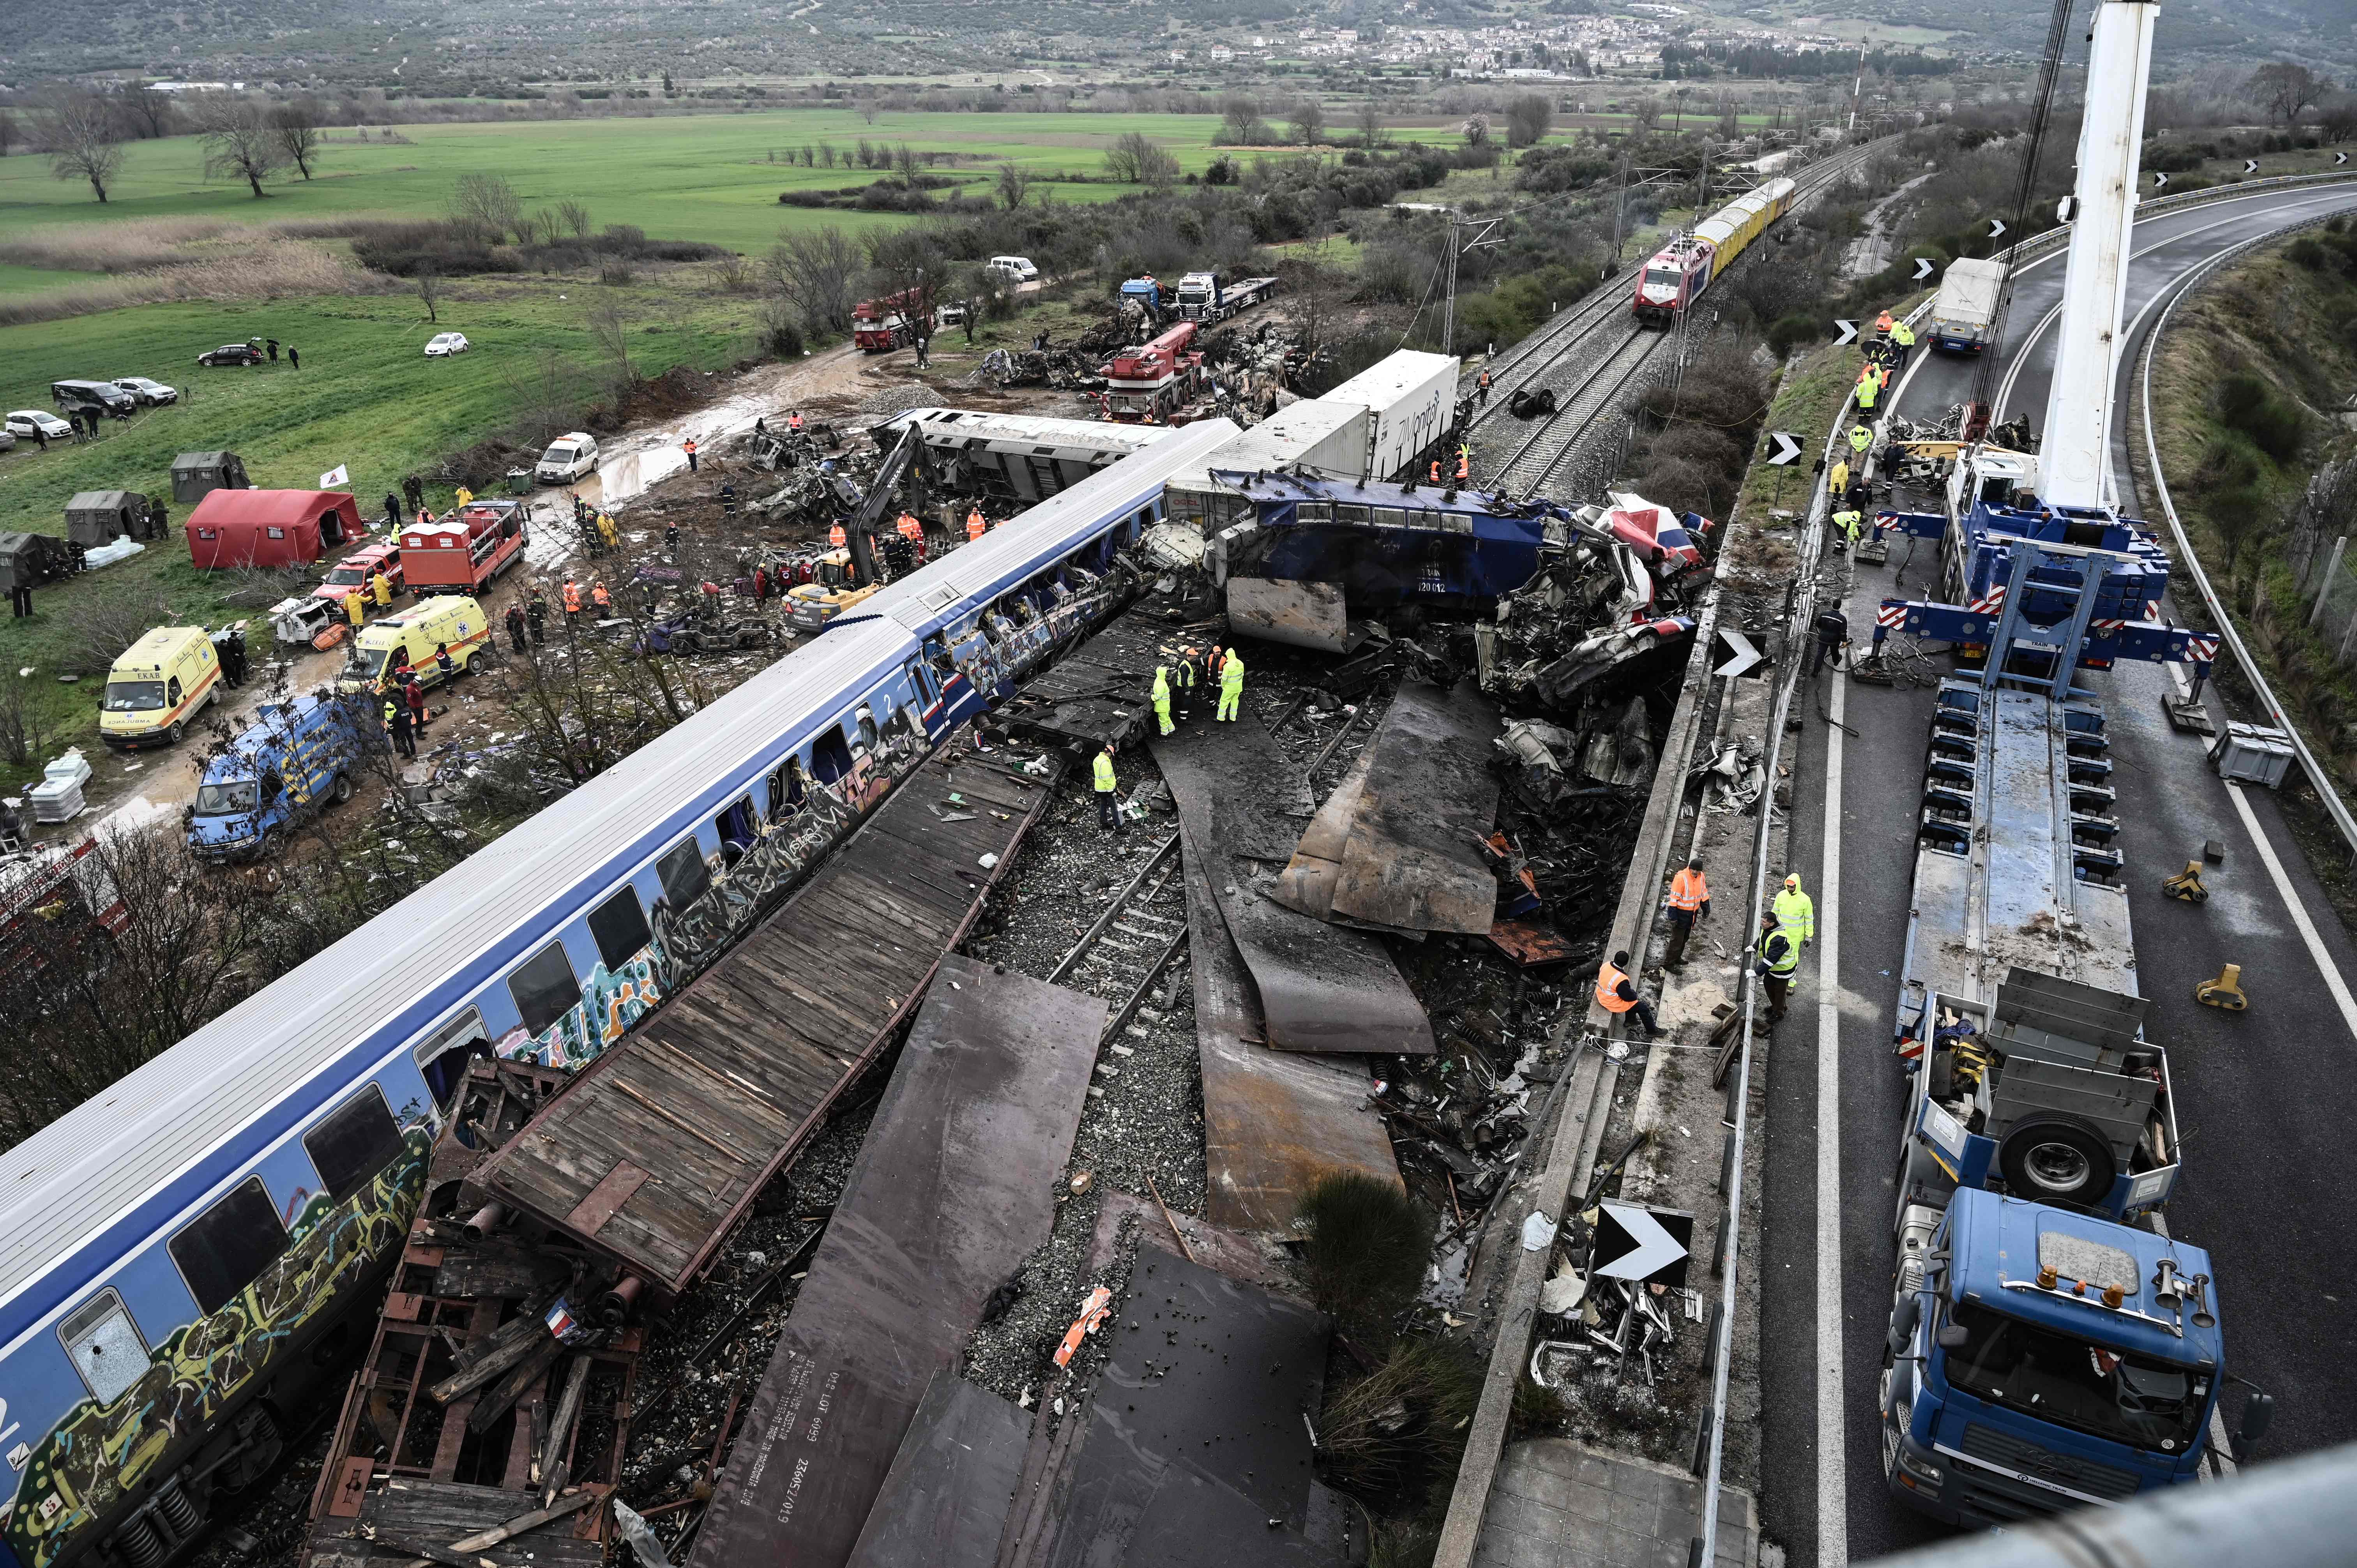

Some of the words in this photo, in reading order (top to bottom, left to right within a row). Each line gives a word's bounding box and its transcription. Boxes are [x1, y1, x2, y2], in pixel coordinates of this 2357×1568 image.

[887, 463, 904, 488] VOLVO
[1419, 582, 1431, 592] 120
[1432, 583, 1446, 593] 012
[883, 694, 894, 715] 2
[826, 1372, 840, 1390] D18
[818, 1394, 831, 1413] LOT
[765, 1425, 779, 1441] MADE
[807, 1418, 823, 1442] 6099
[761, 1442, 772, 1452] IN
[747, 1452, 768, 1487] MACEDONIA
[2016, 1446, 2083, 1478] MAN
[778, 1458, 809, 1524] 236052/019
[2029, 1478, 2051, 1488] HELLENIC
[45, 1499, 57, 1513] 5
